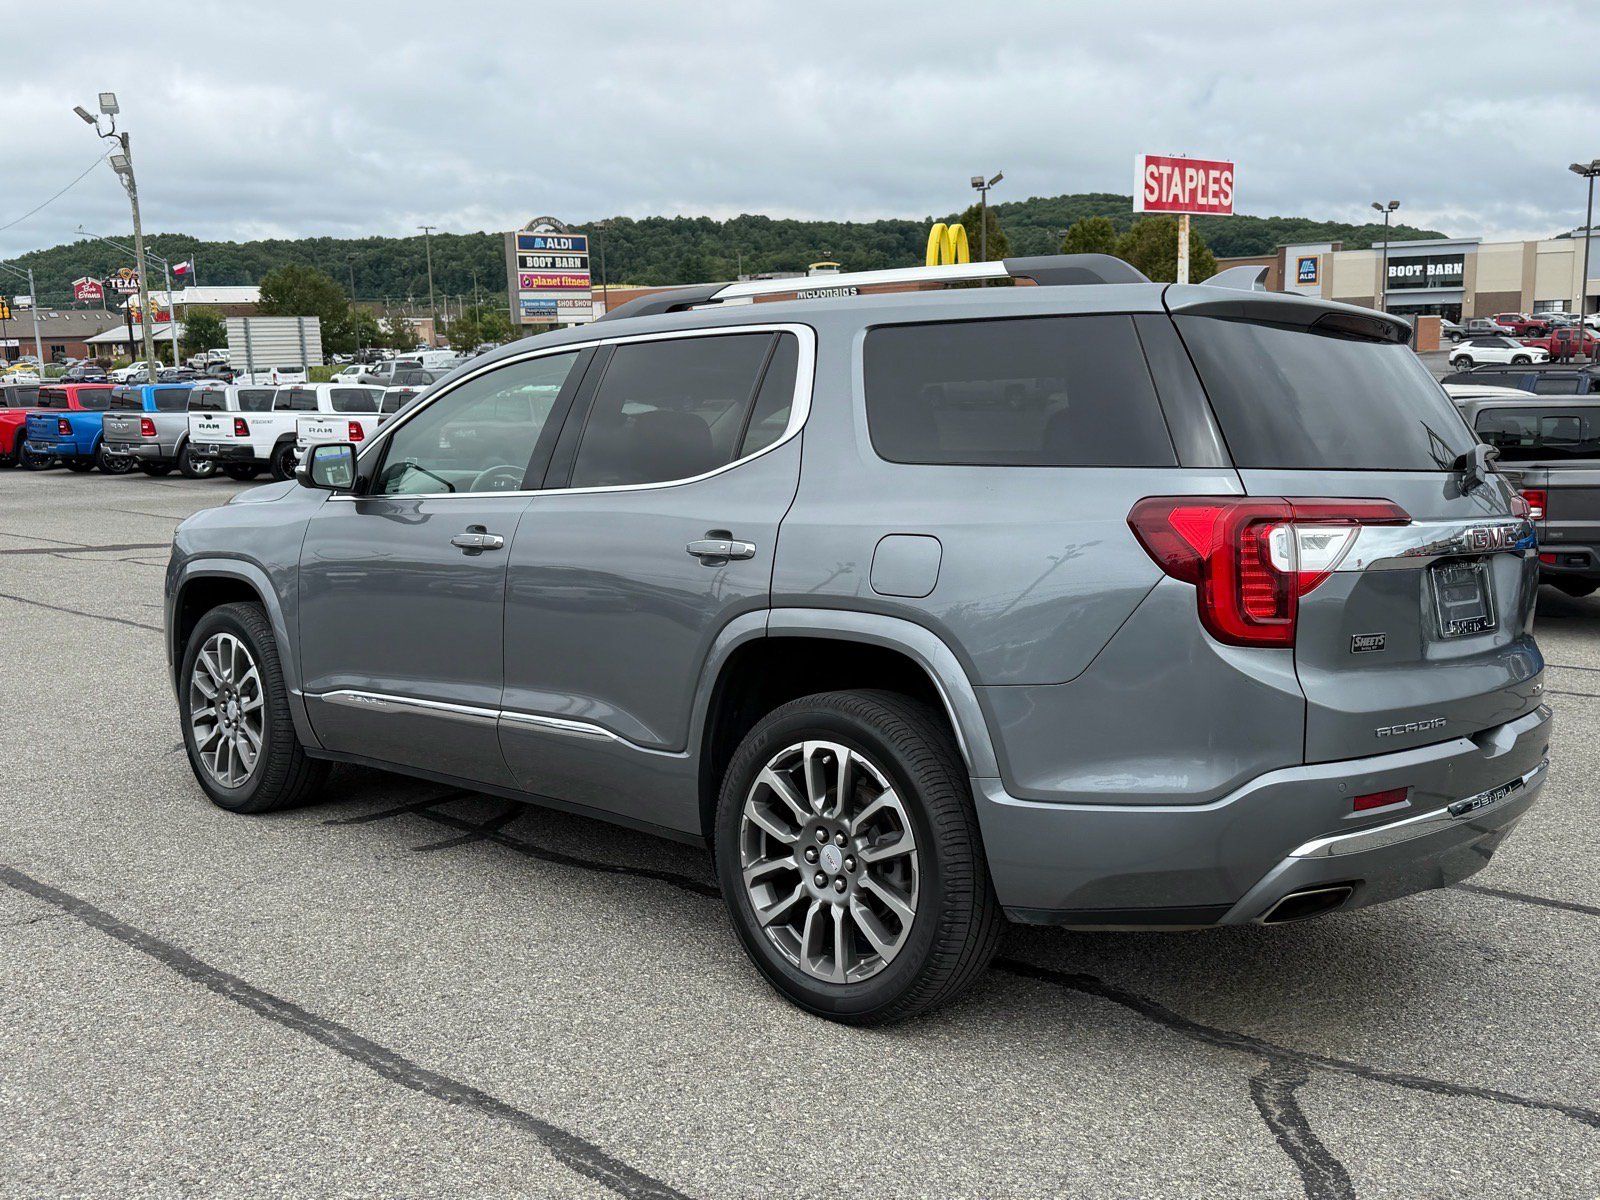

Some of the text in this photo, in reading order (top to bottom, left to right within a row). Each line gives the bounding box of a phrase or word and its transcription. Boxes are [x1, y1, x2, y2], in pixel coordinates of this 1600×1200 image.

[1144, 164, 1233, 206] STAPLES
[546, 238, 573, 250] ALDI
[526, 256, 581, 268] BOOT BARN
[1388, 263, 1463, 278] BOOT BARN
[532, 276, 589, 287] planet fitness
[797, 286, 858, 299] McDonalds
[1471, 526, 1516, 551] GMC
[1354, 634, 1386, 647] SHEETS
[1376, 718, 1447, 738] ACADIA
